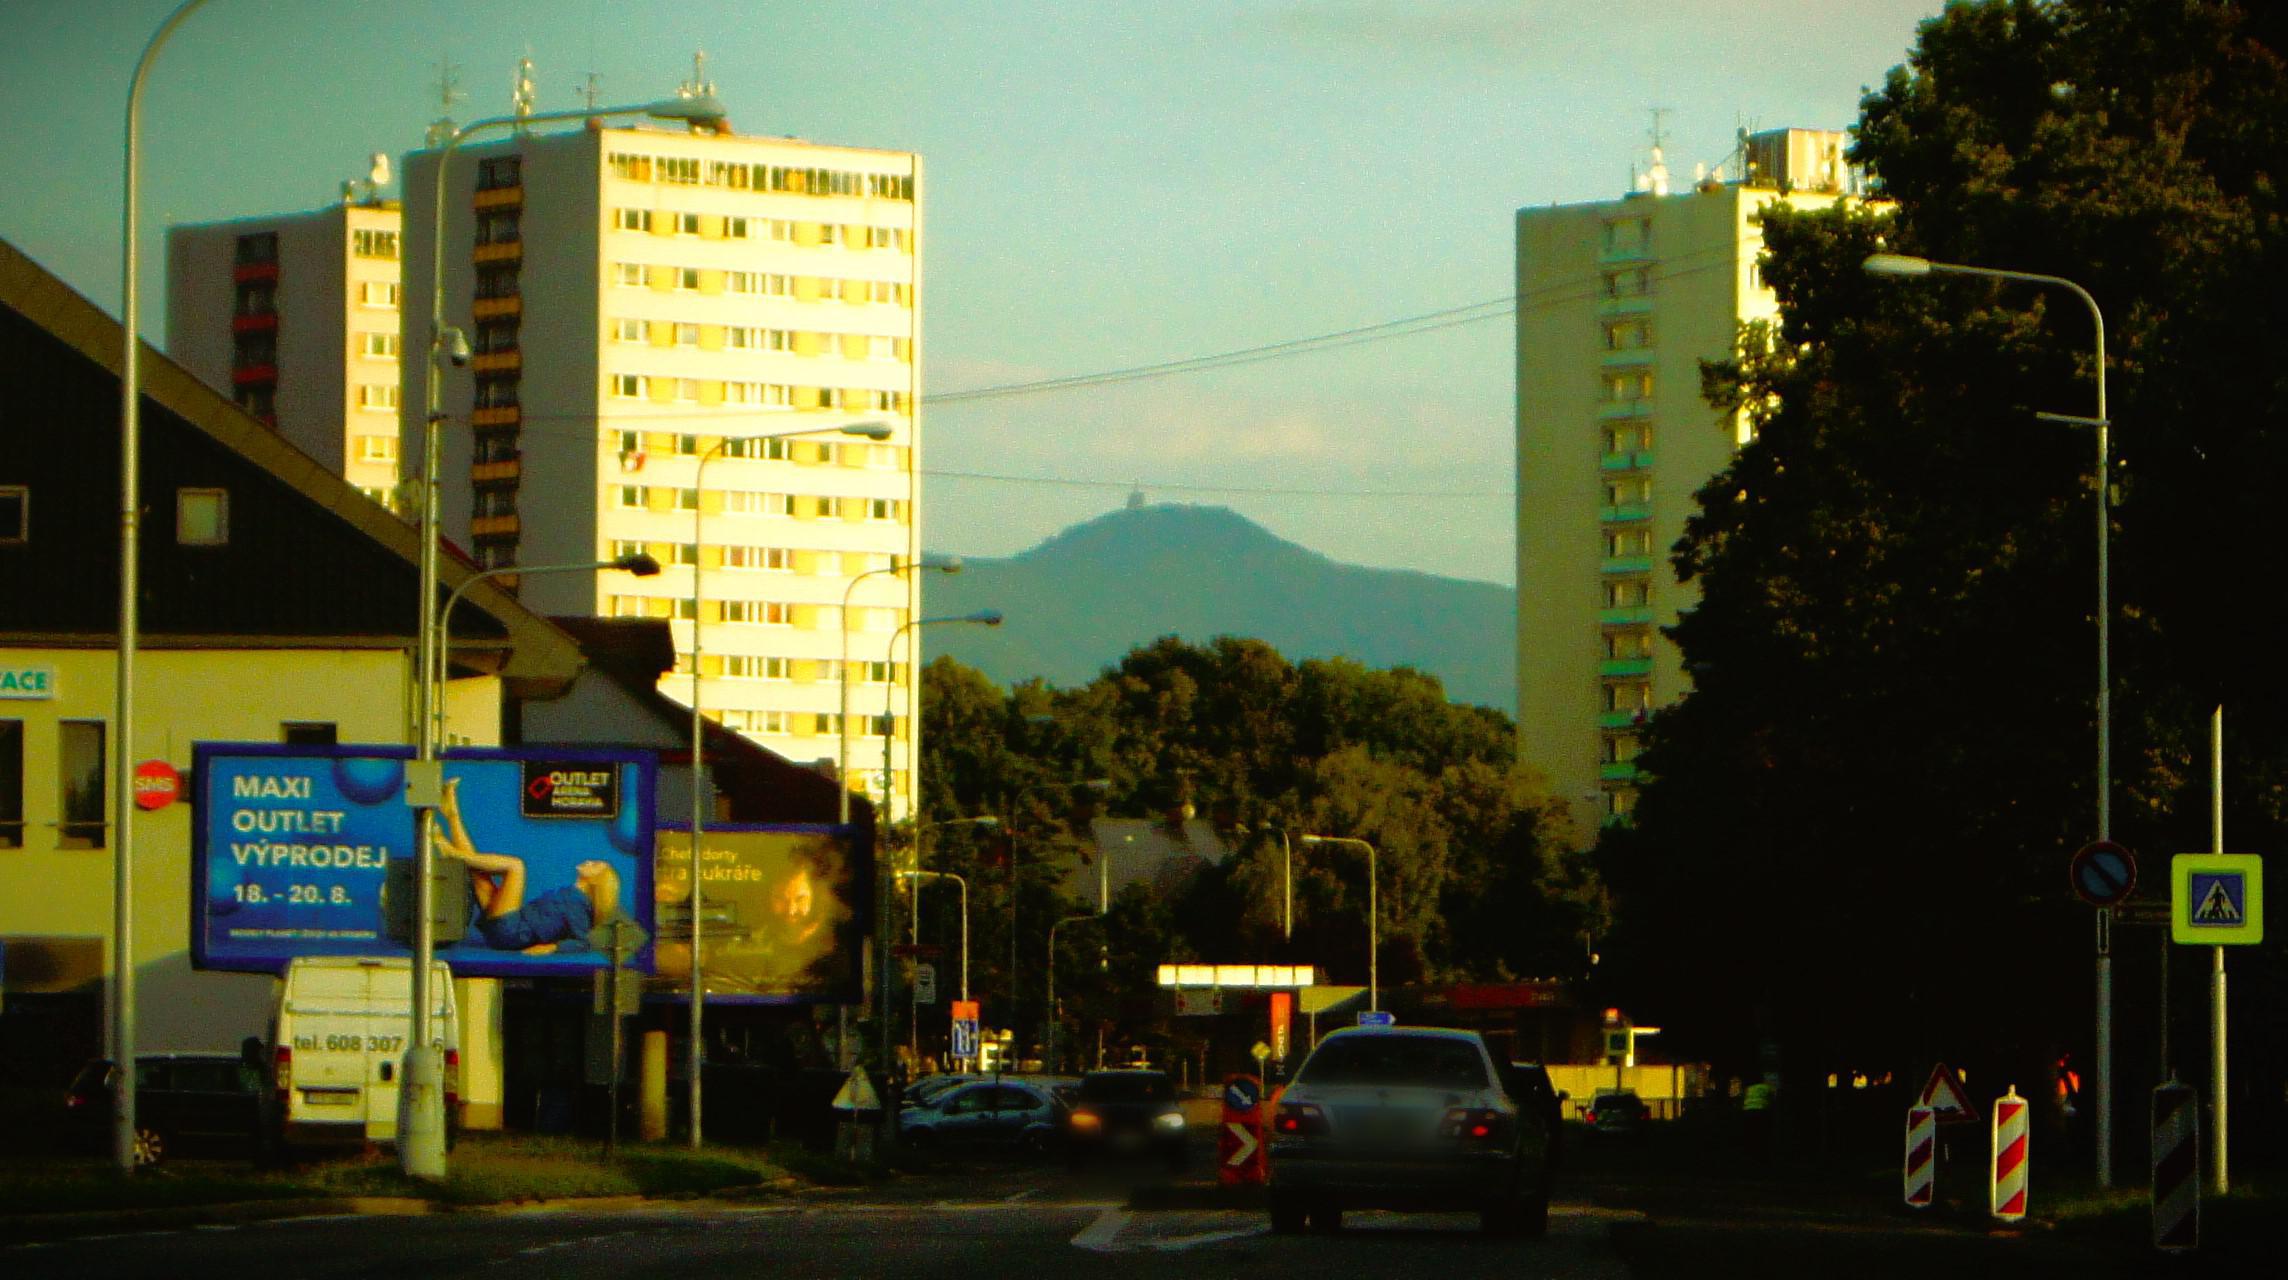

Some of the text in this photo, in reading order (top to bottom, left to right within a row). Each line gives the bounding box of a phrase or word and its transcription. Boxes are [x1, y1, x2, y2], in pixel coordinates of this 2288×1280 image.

[0, 671, 47, 689] ACE
[233, 775, 311, 798] MAXI
[550, 771, 610, 786] OUTLET
[232, 809, 345, 833] OUTLET
[231, 838, 387, 868] VÝPRODEJ
[698, 864, 762, 881] ukráře
[233, 884, 268, 903] 18.
[288, 885, 326, 904] 20.
[330, 885, 352, 904] 8.
[294, 1034, 325, 1050] tel.
[326, 1034, 362, 1050] 608
[367, 1036, 402, 1051] 307
